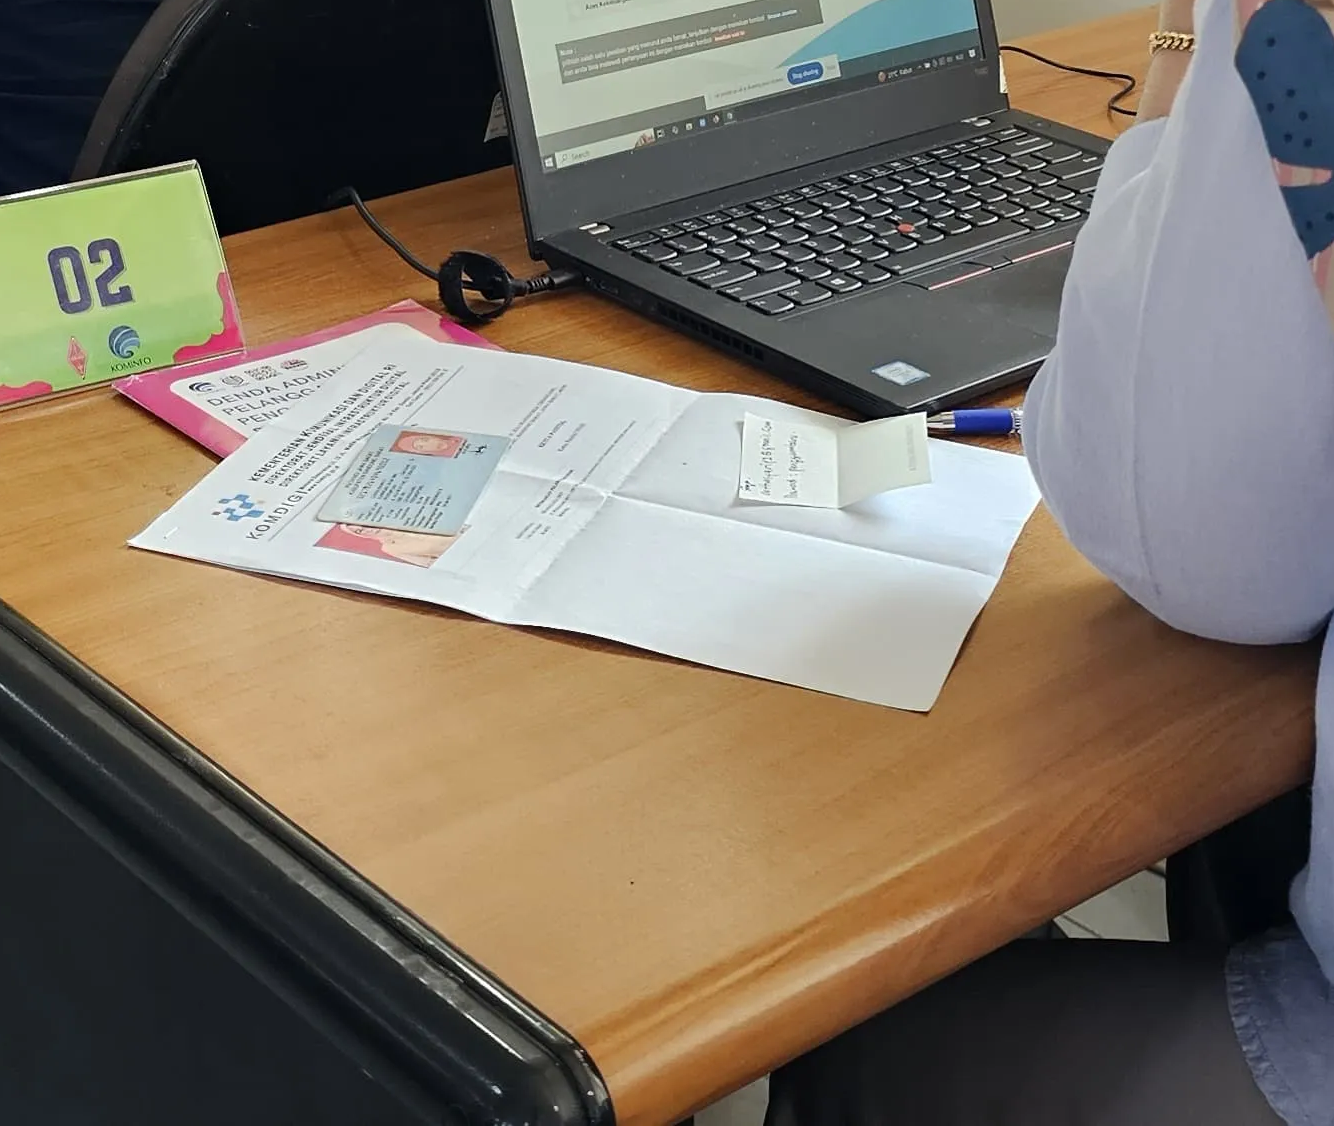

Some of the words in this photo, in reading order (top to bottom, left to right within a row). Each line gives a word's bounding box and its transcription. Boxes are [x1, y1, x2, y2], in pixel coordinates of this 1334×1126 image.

[46, 237, 135, 316] 02
[110, 356, 152, 374] KOMINFO
[207, 386, 280, 407] DENDA
[248, 437, 303, 483] KEMENTERIAN
[361, 370, 390, 394] DIGITAL
[264, 450, 308, 485] DIREKTORAT
[278, 455, 319, 488] DIREKTORAT
[246, 484, 308, 541] KOMDIGI
